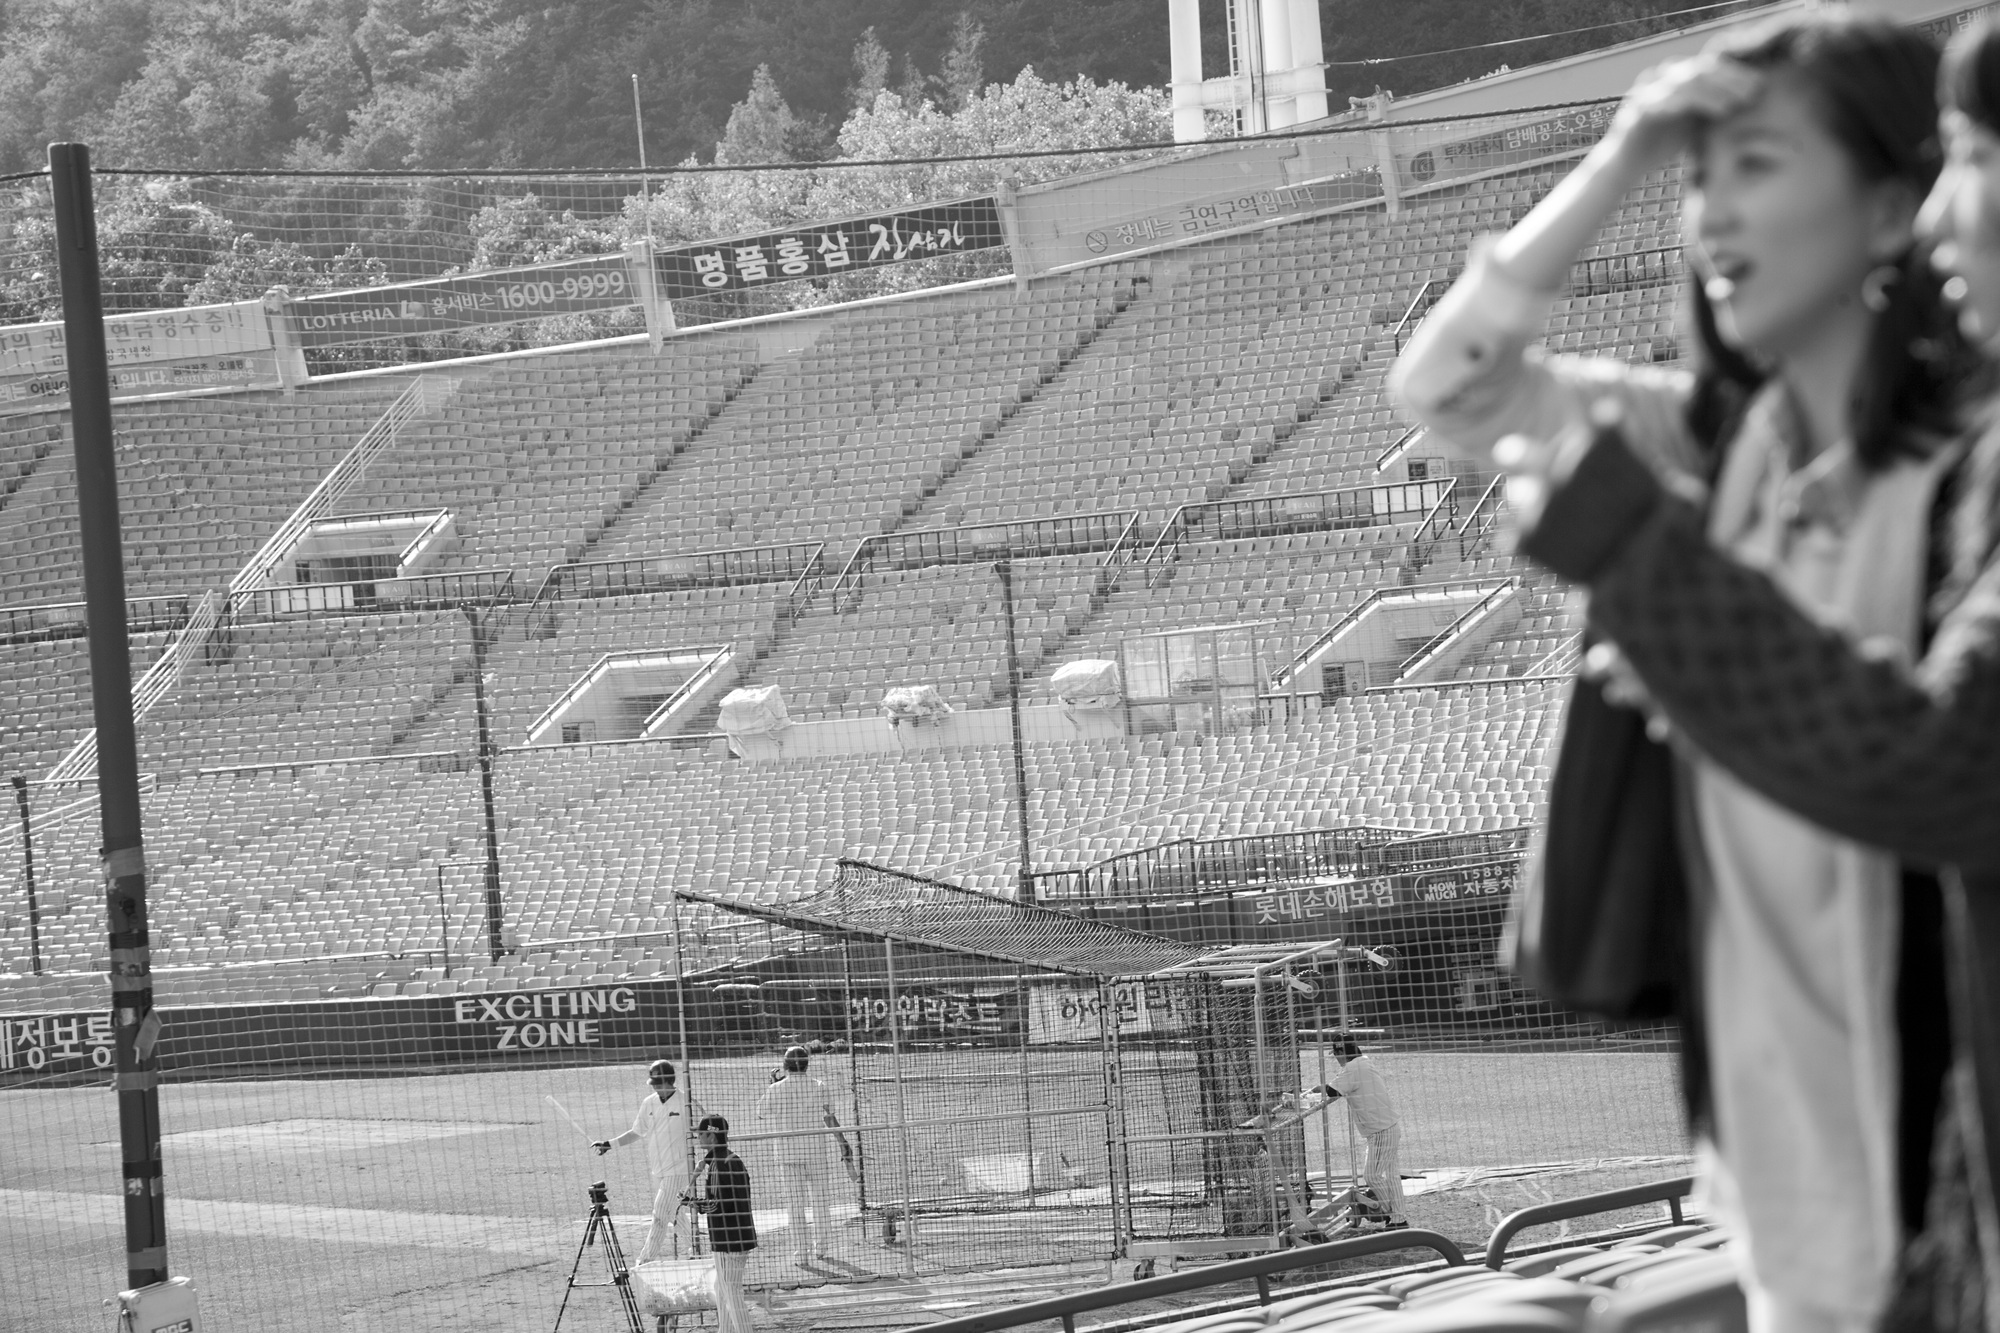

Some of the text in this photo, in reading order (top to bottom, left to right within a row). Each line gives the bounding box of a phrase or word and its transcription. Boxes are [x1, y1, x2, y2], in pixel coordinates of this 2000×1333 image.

[1115, 216, 1174, 245] 장내는
[302, 305, 396, 331] LOTTERIA
[432, 291, 495, 316] 홈서비스
[497, 270, 625, 310] 1600-9999
[111, 309, 244, 343] 현금영수증!!
[1255, 878, 1395, 925] 롯데손해보험
[1424, 890, 1458, 902] MUCH
[1428, 881, 1456, 894] HOW
[455, 987, 636, 1023] EXCITING
[495, 1020, 599, 1050] ZONE
